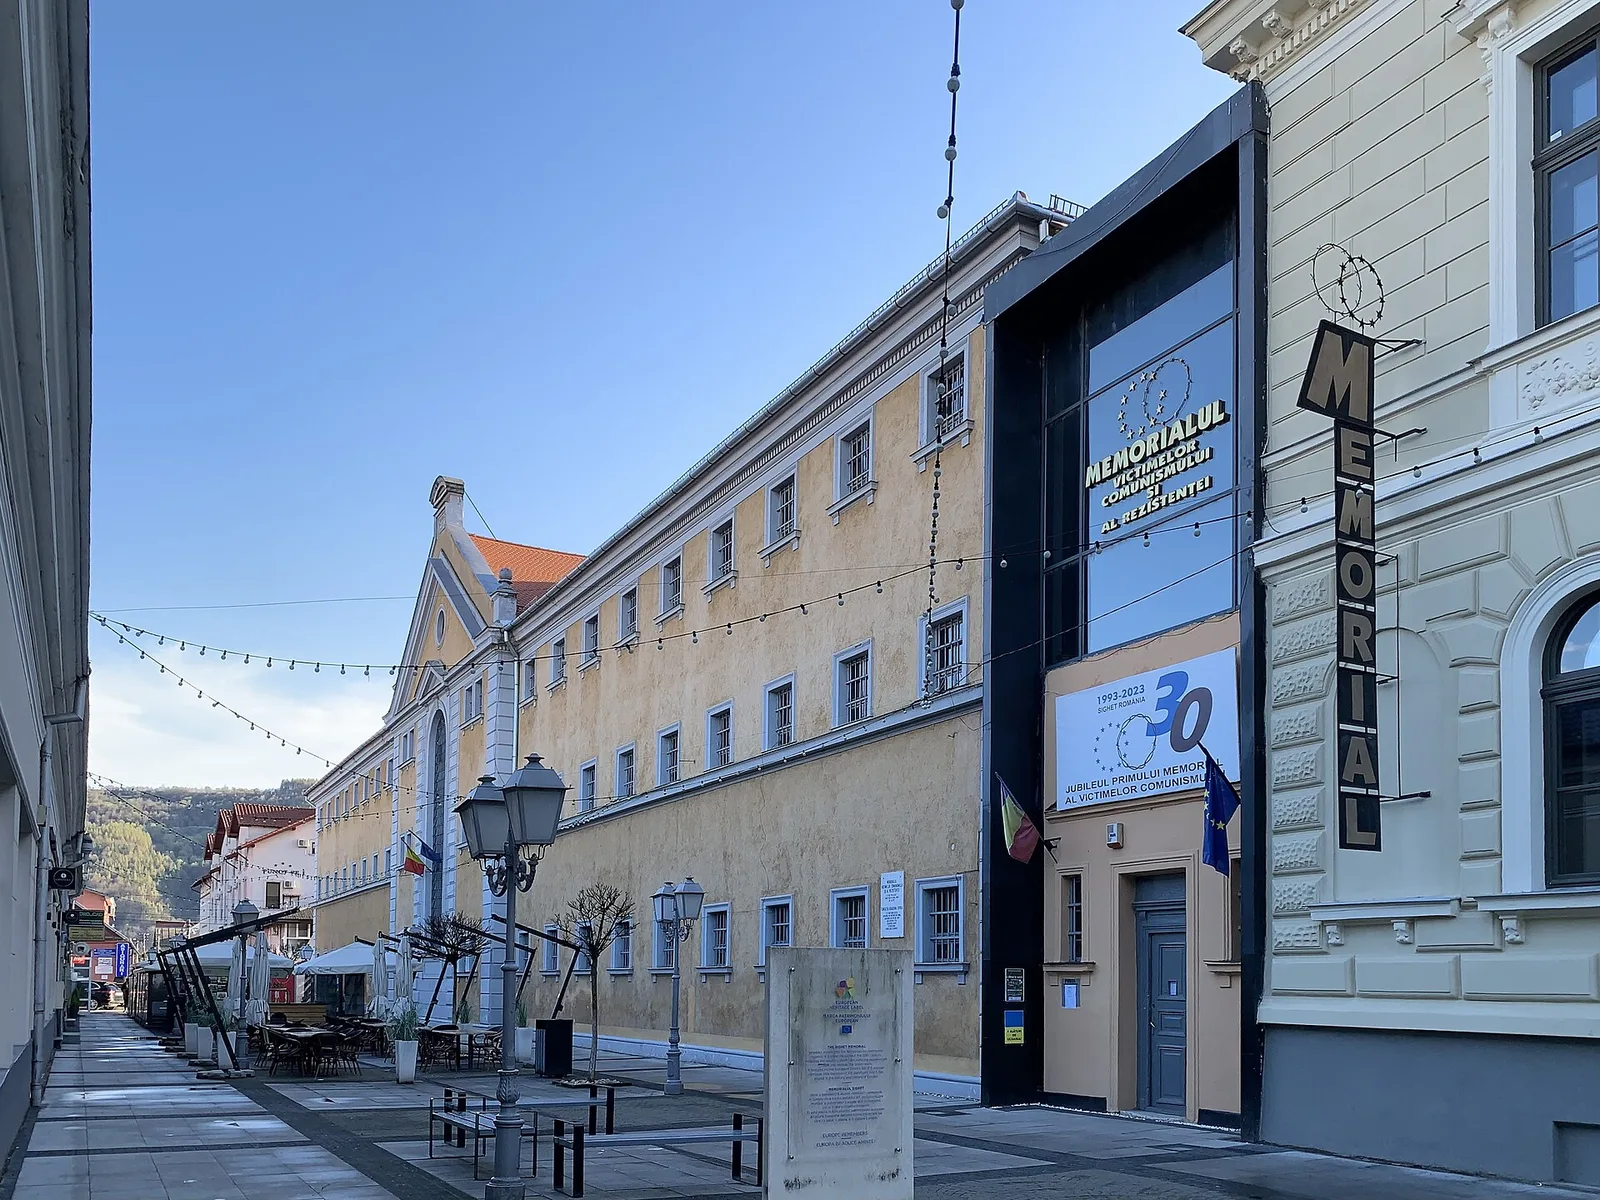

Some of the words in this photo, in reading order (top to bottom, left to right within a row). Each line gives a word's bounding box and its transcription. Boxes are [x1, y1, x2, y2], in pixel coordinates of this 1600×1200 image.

[1085, 400, 1229, 488] MEMORIALUL
[1112, 440, 1199, 488] VICTIMELOR
[1101, 447, 1212, 507] COMUNISMULUI
[1101, 518, 1119, 534] AL
[1306, 330, 1377, 846] MEMORIAL
[1097, 684, 1145, 705] 1993-2023
[1097, 703, 1118, 714] SIGHET
[1146, 671, 1213, 753] 30
[1065, 778, 1110, 794] JUBILEUL
[1112, 769, 1160, 786] PRIMULUI
[1163, 758, 1224, 776] MEMORL
[1065, 796, 1077, 805] AL
[1078, 786, 1138, 803] VICTIMELOR
